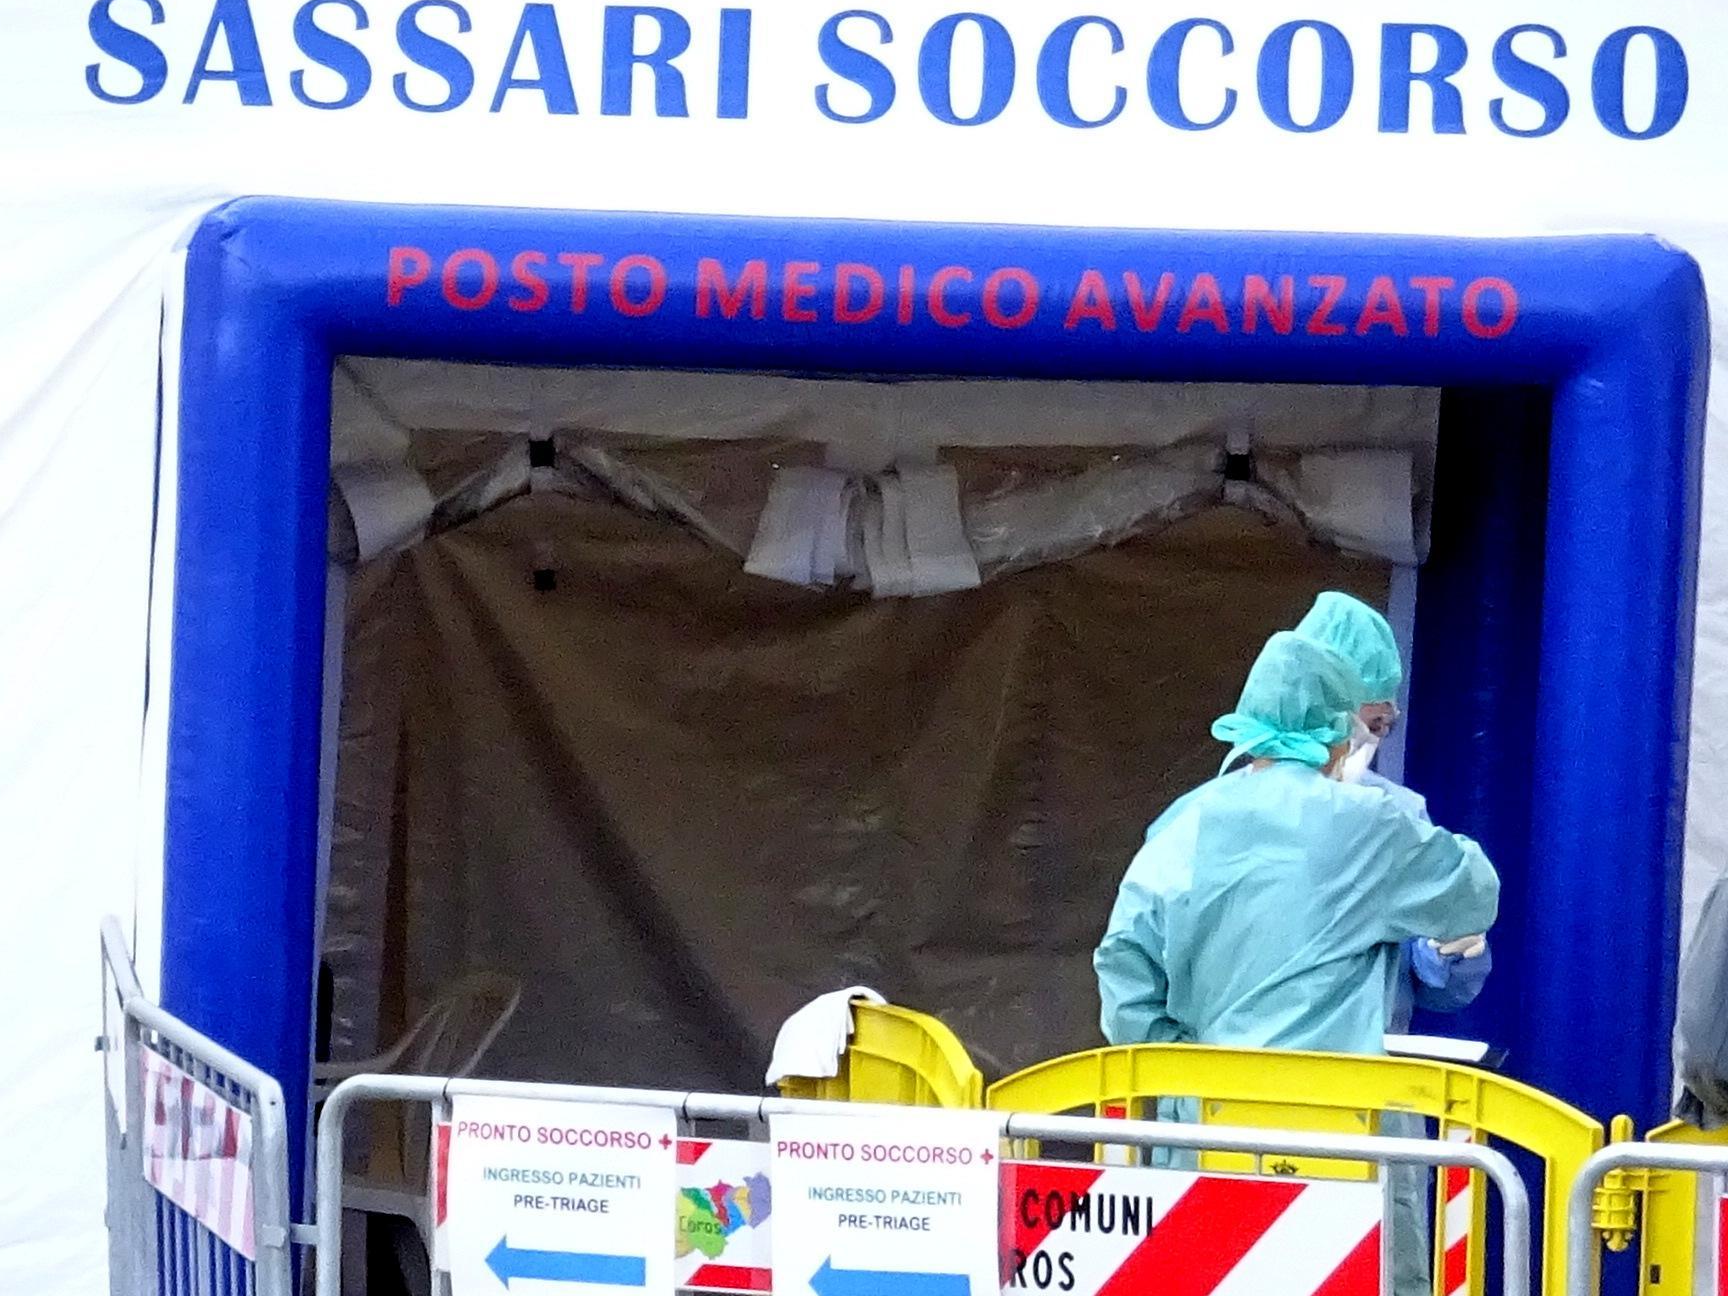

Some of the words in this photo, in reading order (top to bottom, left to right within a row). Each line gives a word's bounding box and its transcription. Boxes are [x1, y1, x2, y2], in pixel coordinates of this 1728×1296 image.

[814, 8, 1690, 141] SOCCORSO
[386, 246, 668, 318] POSTO
[694, 257, 1040, 330] MEDICO
[1062, 268, 1521, 339] AVANZATO
[457, 1120, 532, 1143] PRONTO
[536, 1126, 653, 1150] SOCCORSO
[776, 1140, 855, 1161] PRONTO
[859, 1143, 973, 1165] SOCCORSO
[482, 1166, 564, 1186] INGRESSO
[568, 1172, 642, 1190] PAZIENTI
[513, 1194, 610, 1214] PRE-TRIAGE
[807, 1186, 887, 1205] INGRESSO
[890, 1189, 962, 1206] PAZIENTI
[678, 1214, 723, 1235] Coros
[837, 1213, 931, 1232] PRE-TRIAGE
[1019, 1188, 1155, 1238] COMUNI
[1008, 1247, 1075, 1292] ROS
